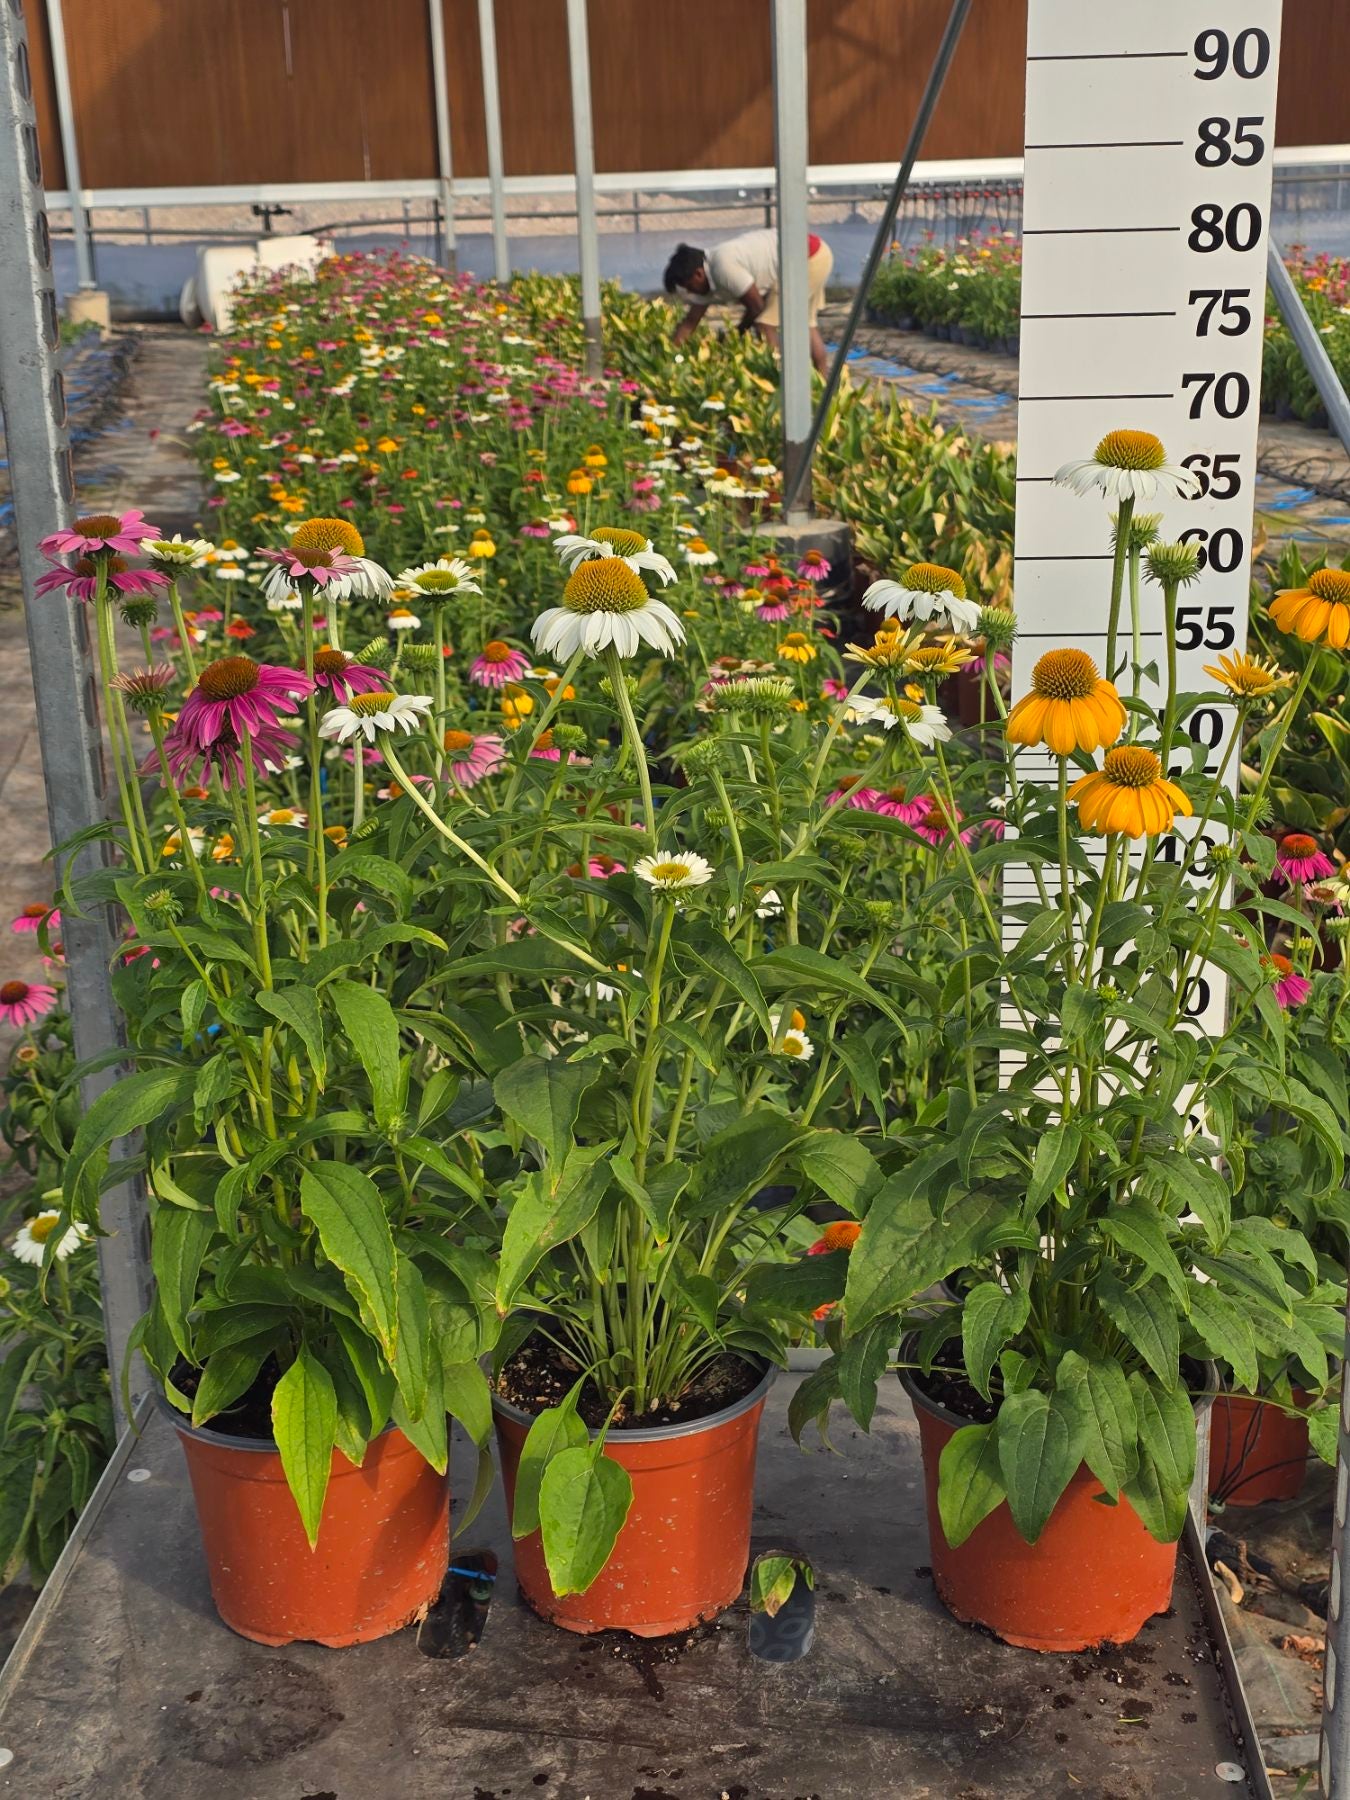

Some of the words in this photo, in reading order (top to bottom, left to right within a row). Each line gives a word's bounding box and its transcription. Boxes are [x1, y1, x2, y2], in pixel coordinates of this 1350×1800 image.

[1194, 28, 1270, 80] 90
[1195, 117, 1265, 167] 85
[1188, 203, 1262, 253] 80
[1189, 289, 1251, 337] 75
[1182, 372, 1250, 419] 70
[1176, 454, 1241, 500] 65
[1175, 607, 1235, 651] 55
[1158, 709, 1224, 750] 0
